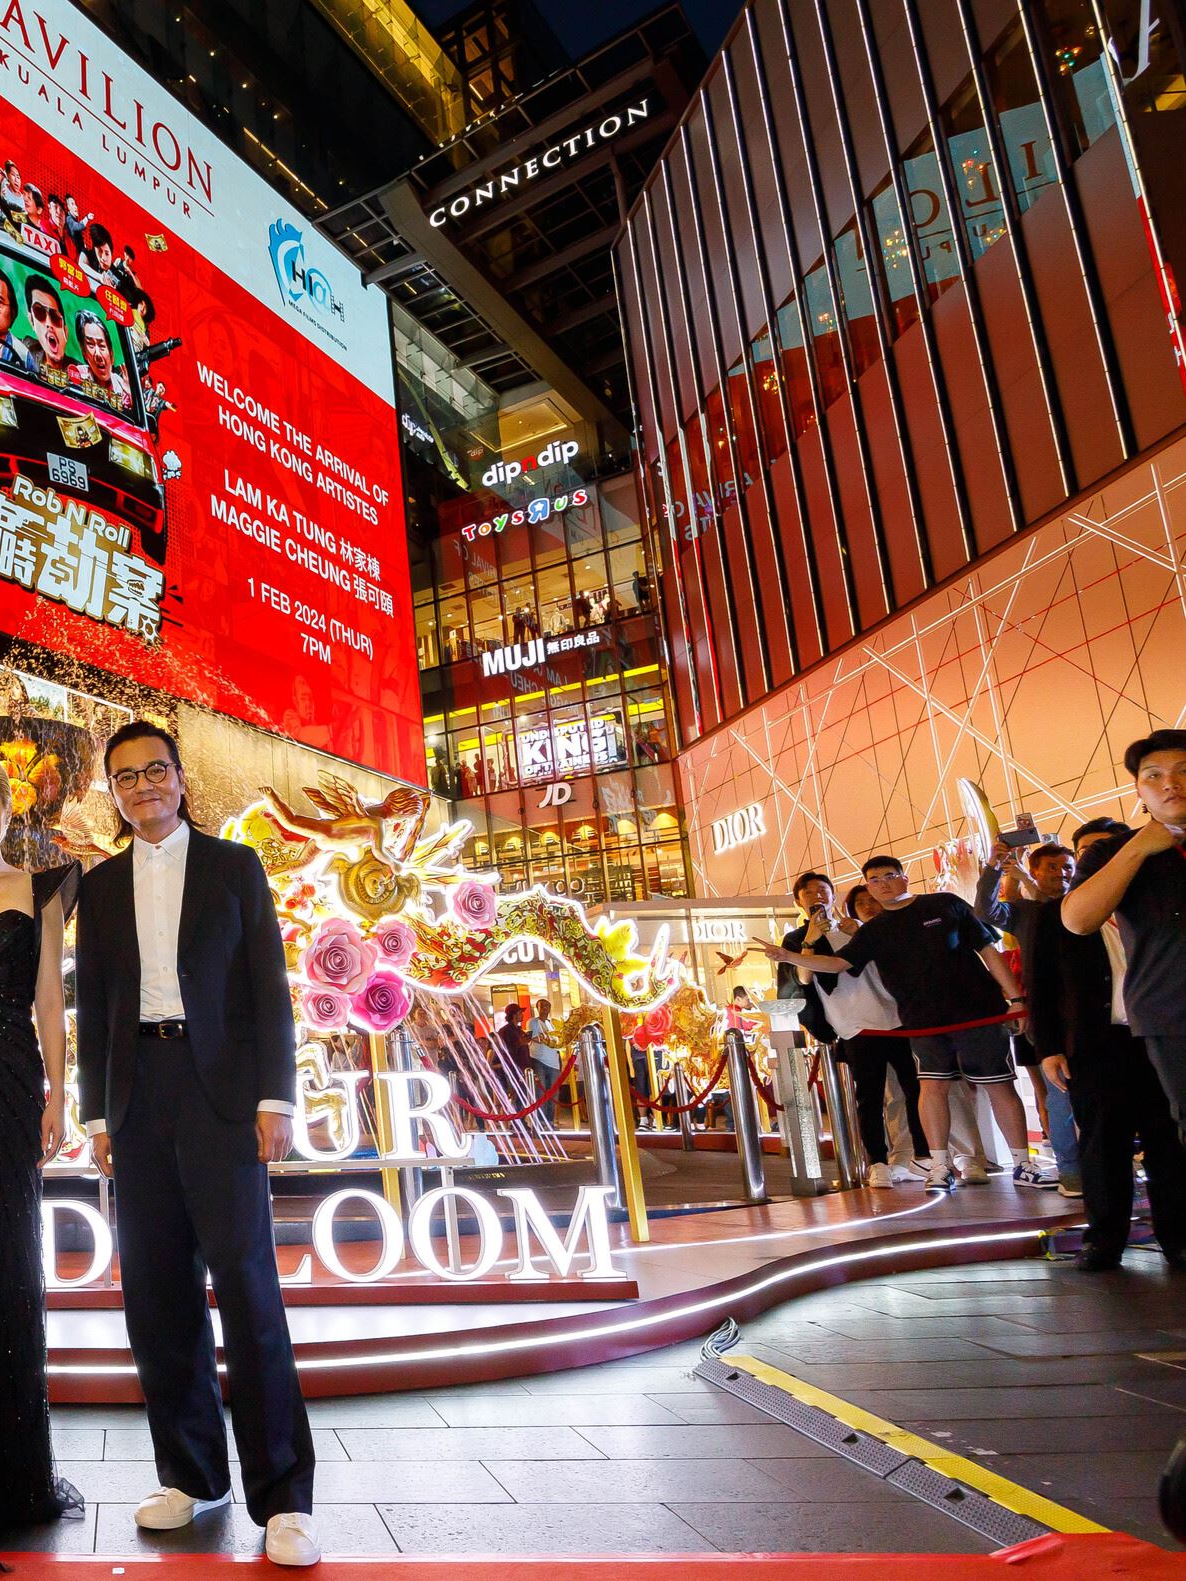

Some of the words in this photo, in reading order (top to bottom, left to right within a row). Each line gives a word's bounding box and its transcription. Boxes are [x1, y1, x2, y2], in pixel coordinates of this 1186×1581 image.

[101, 133, 192, 219] LUMPUR
[429, 98, 648, 228] CONNECTION
[23, 226, 60, 254] TAXI
[58, 455, 77, 475] PS
[196, 360, 281, 435] WELCOME
[283, 420, 313, 457] THE
[315, 444, 371, 496] ARRIVAL
[372, 483, 389, 507] OF
[218, 404, 267, 453] HONG
[269, 438, 314, 484] KONG
[316, 471, 379, 526] ARTISTES
[13, 475, 63, 514] Rob
[65, 502, 86, 527] N
[89, 512, 131, 548] Roll
[51, 468, 87, 489] 6969
[210, 493, 282, 554] MAGGIE
[284, 538, 351, 593] CHEUNG
[353, 573, 394, 619] 張可頤
[224, 469, 262, 511] LAM
[266, 494, 291, 528] KA
[292, 510, 336, 555] TUNG
[339, 537, 382, 583] 林家棟
[247, 577, 255, 598] 1
[260, 582, 291, 616] FEB
[294, 600, 327, 633] 2024
[329, 617, 374, 661] (THUR)
[300, 632, 332, 665] 7PM
[481, 638, 546, 677] MUJI
[546, 630, 600, 655] 無印良品
[538, 782, 572, 809] JD
[710, 804, 763, 852] DIOR
